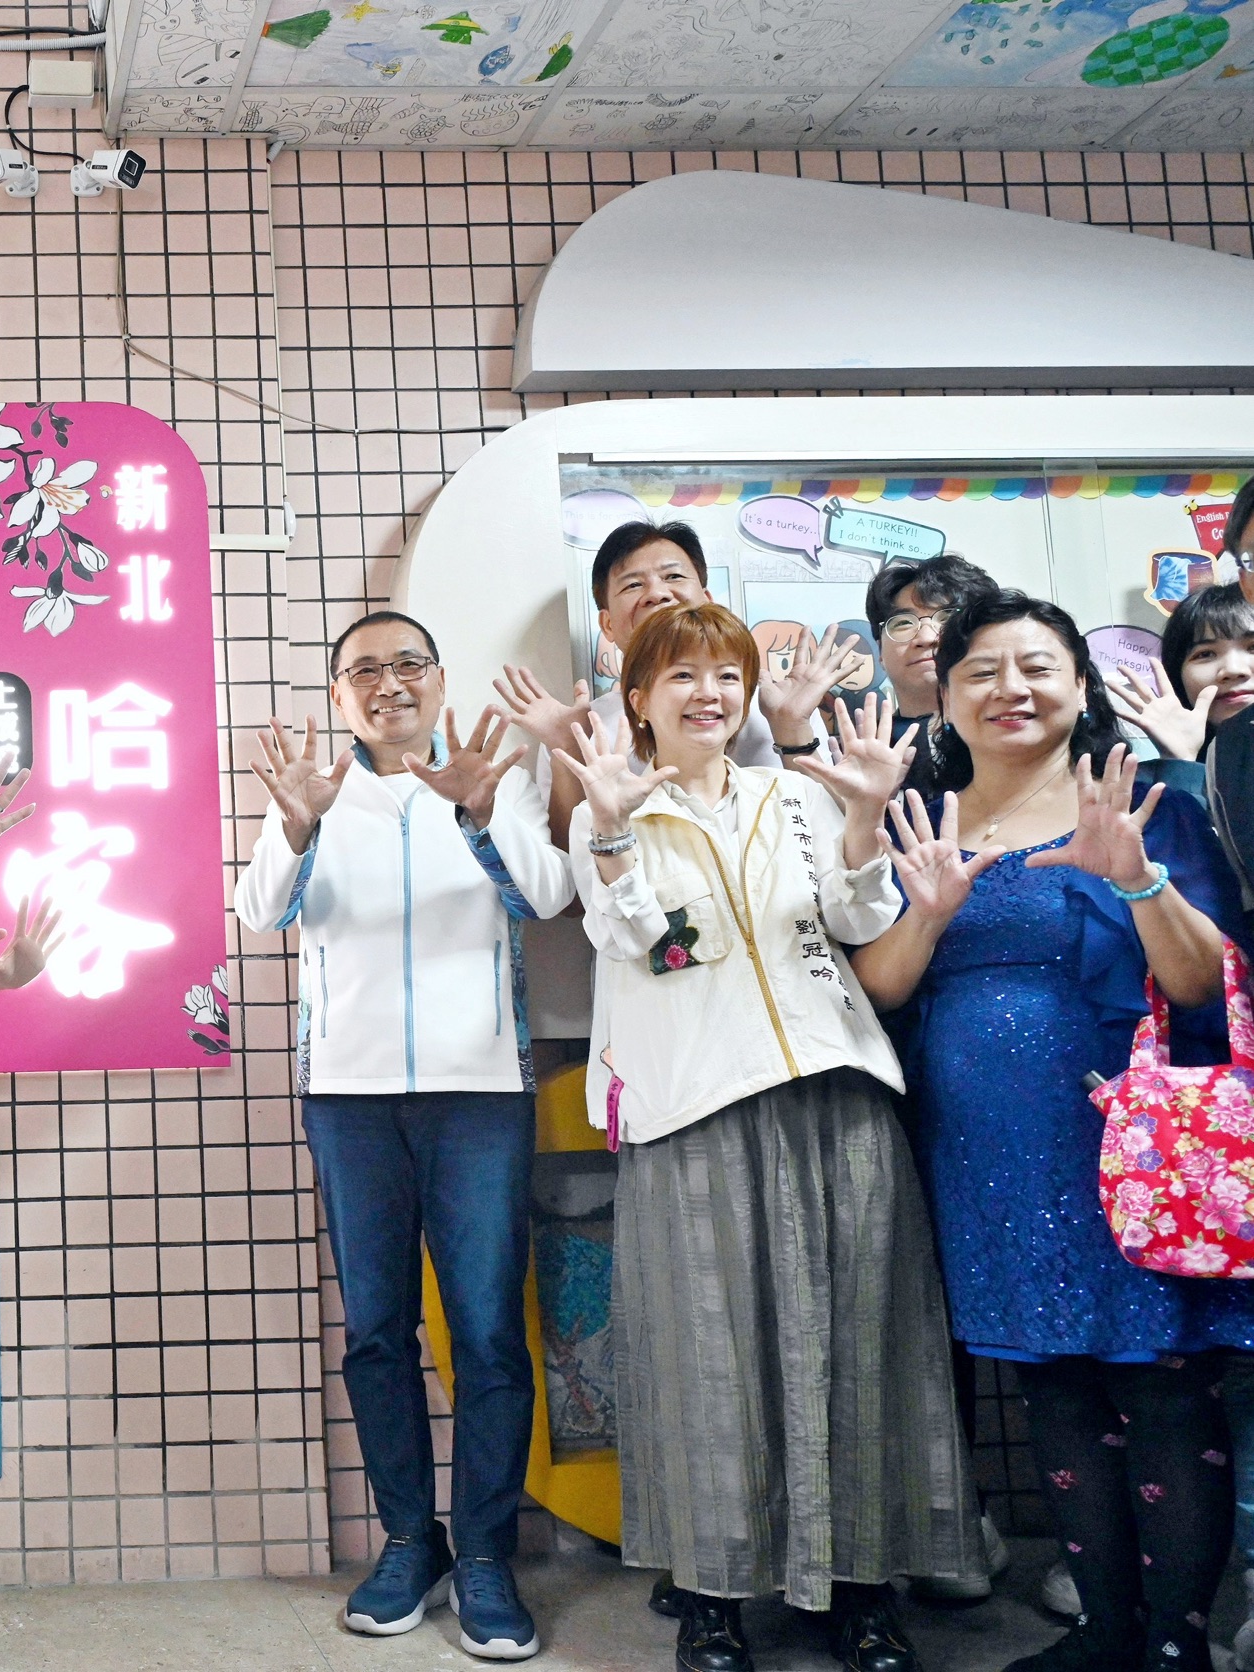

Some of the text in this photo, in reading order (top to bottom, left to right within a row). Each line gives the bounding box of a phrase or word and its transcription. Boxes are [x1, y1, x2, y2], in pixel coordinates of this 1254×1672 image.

[744, 513, 762, 525] It's
[765, 519, 773, 527] a
[1195, 512, 1224, 523] English
[855, 518, 918, 538] A TURKEY!!
[114, 464, 173, 621] 新北
[839, 529, 844, 539] I
[847, 532, 876, 544] don't
[880, 537, 905, 550] think
[1118, 639, 1153, 656] Happy
[1098, 651, 1151, 672] Thanksgiv
[3, 681, 174, 999] 哈客
